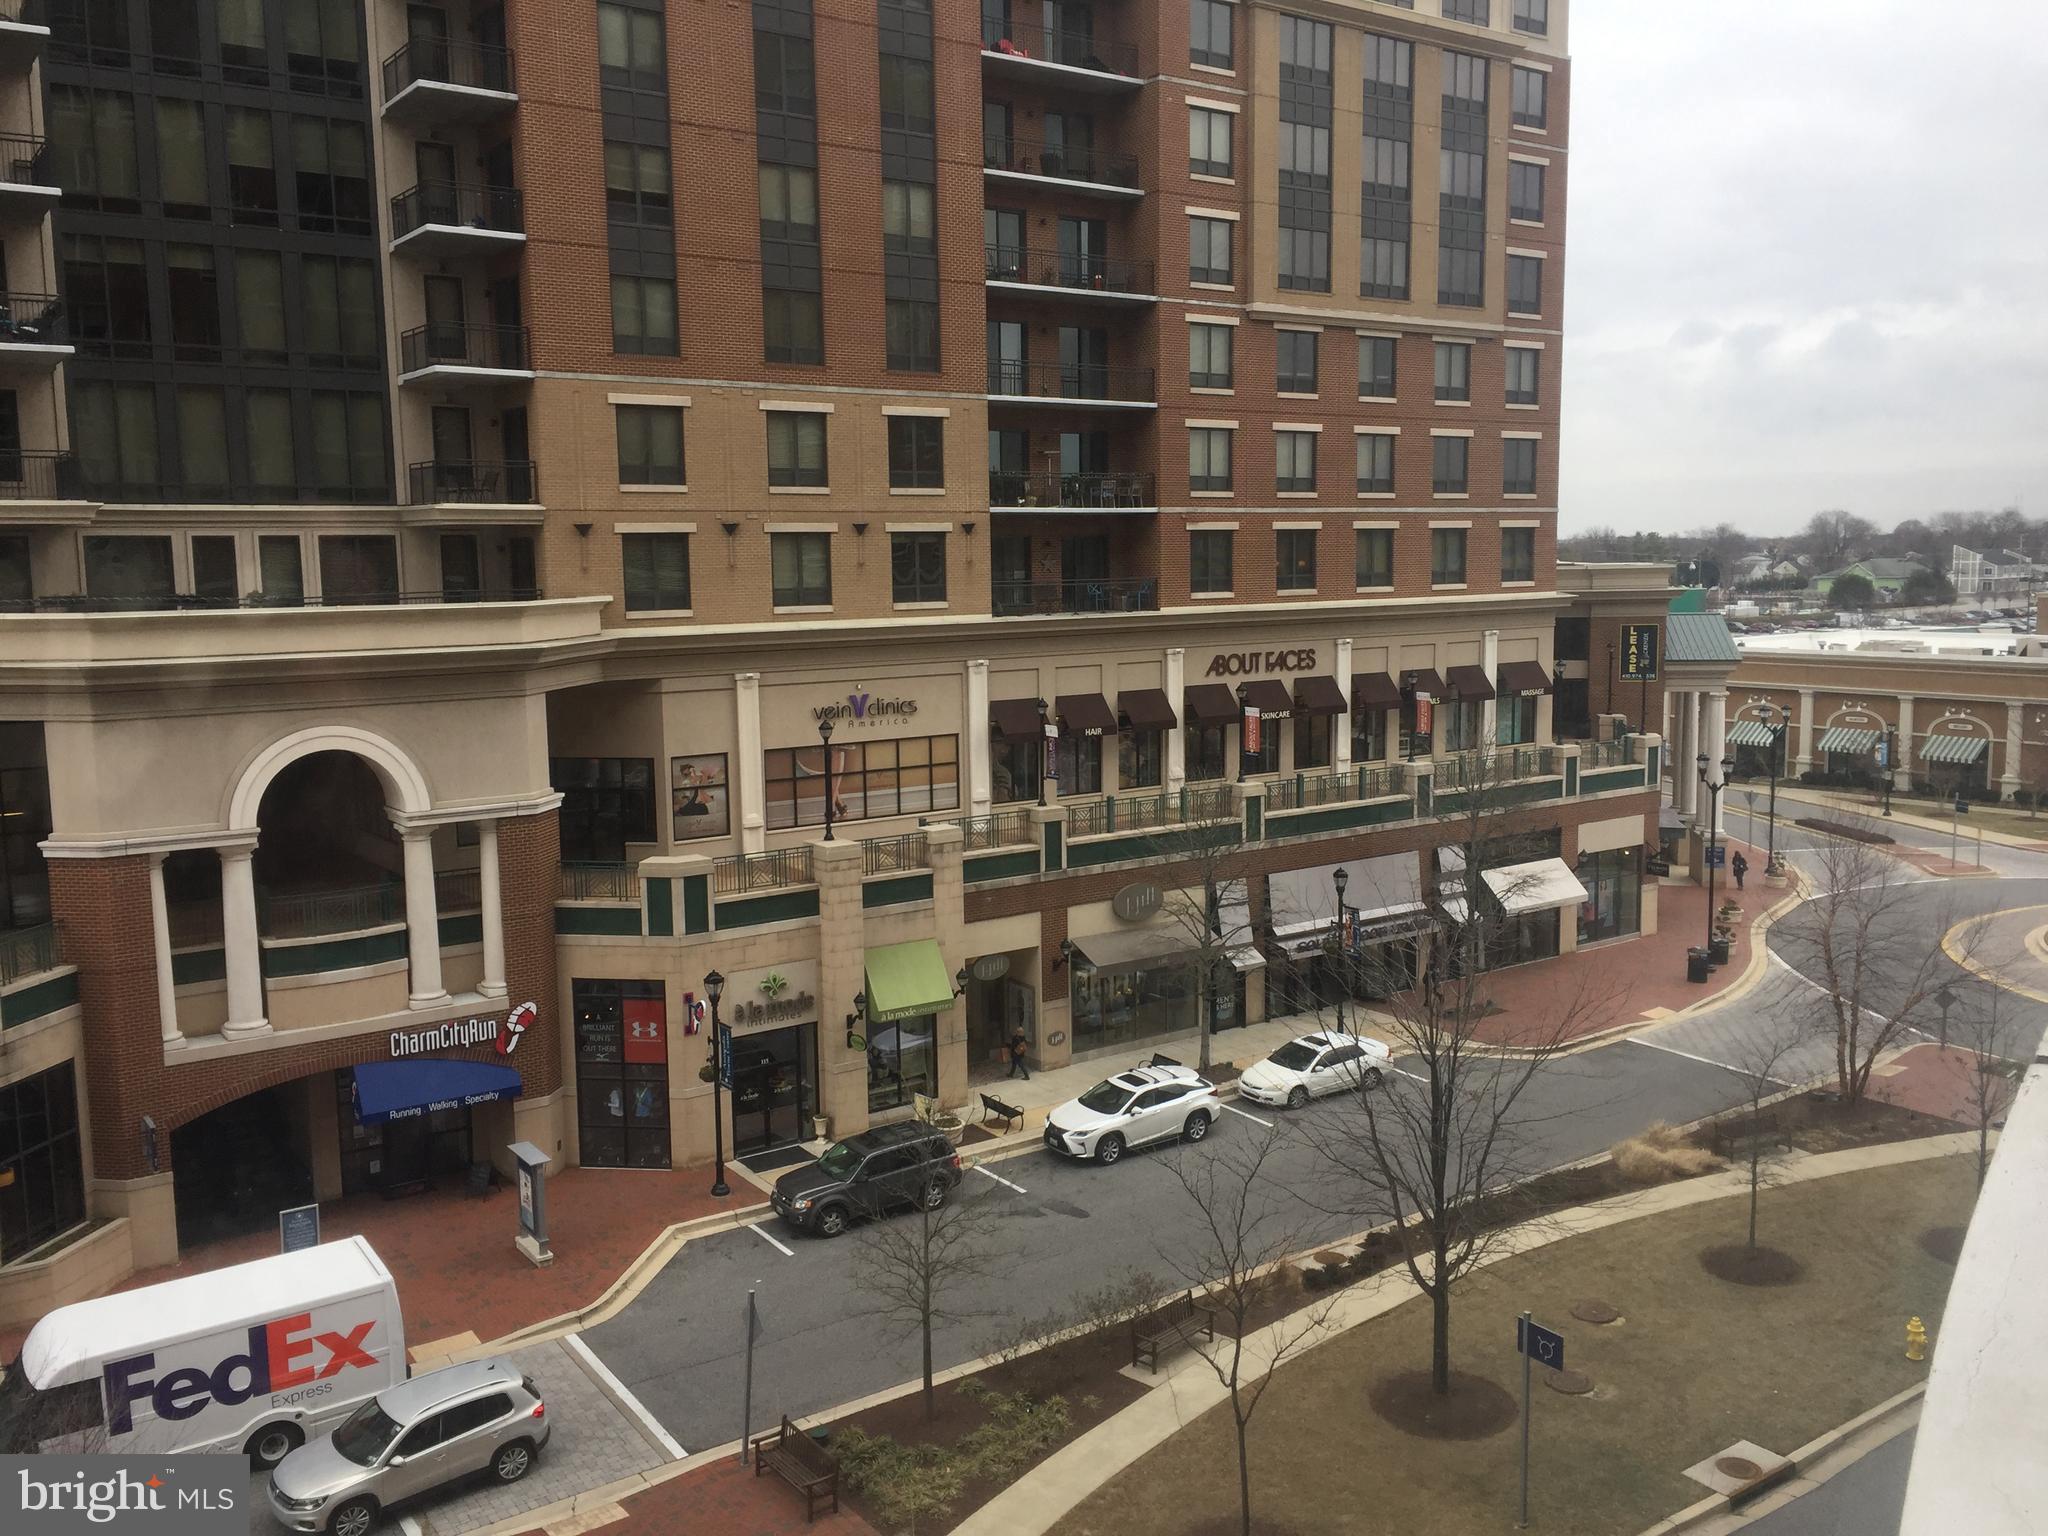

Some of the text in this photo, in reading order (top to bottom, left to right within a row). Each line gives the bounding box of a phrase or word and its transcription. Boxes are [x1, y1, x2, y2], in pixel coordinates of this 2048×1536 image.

[1205, 648, 1317, 678] ABOUT FACES
[1629, 626, 1637, 673] LEASE
[1520, 688, 1545, 697] MASSAGE
[813, 702, 852, 720] vein
[868, 697, 918, 717] clinics
[1260, 710, 1291, 720] SKINCARE
[1085, 727, 1103, 736] HAIR
[895, 1007, 917, 1019] mode
[390, 1019, 497, 1057] CharmCityRun
[390, 1091, 499, 1120] Running Walking Specialty
[103, 1312, 379, 1437] FedEx
[270, 1382, 333, 1411] Express
